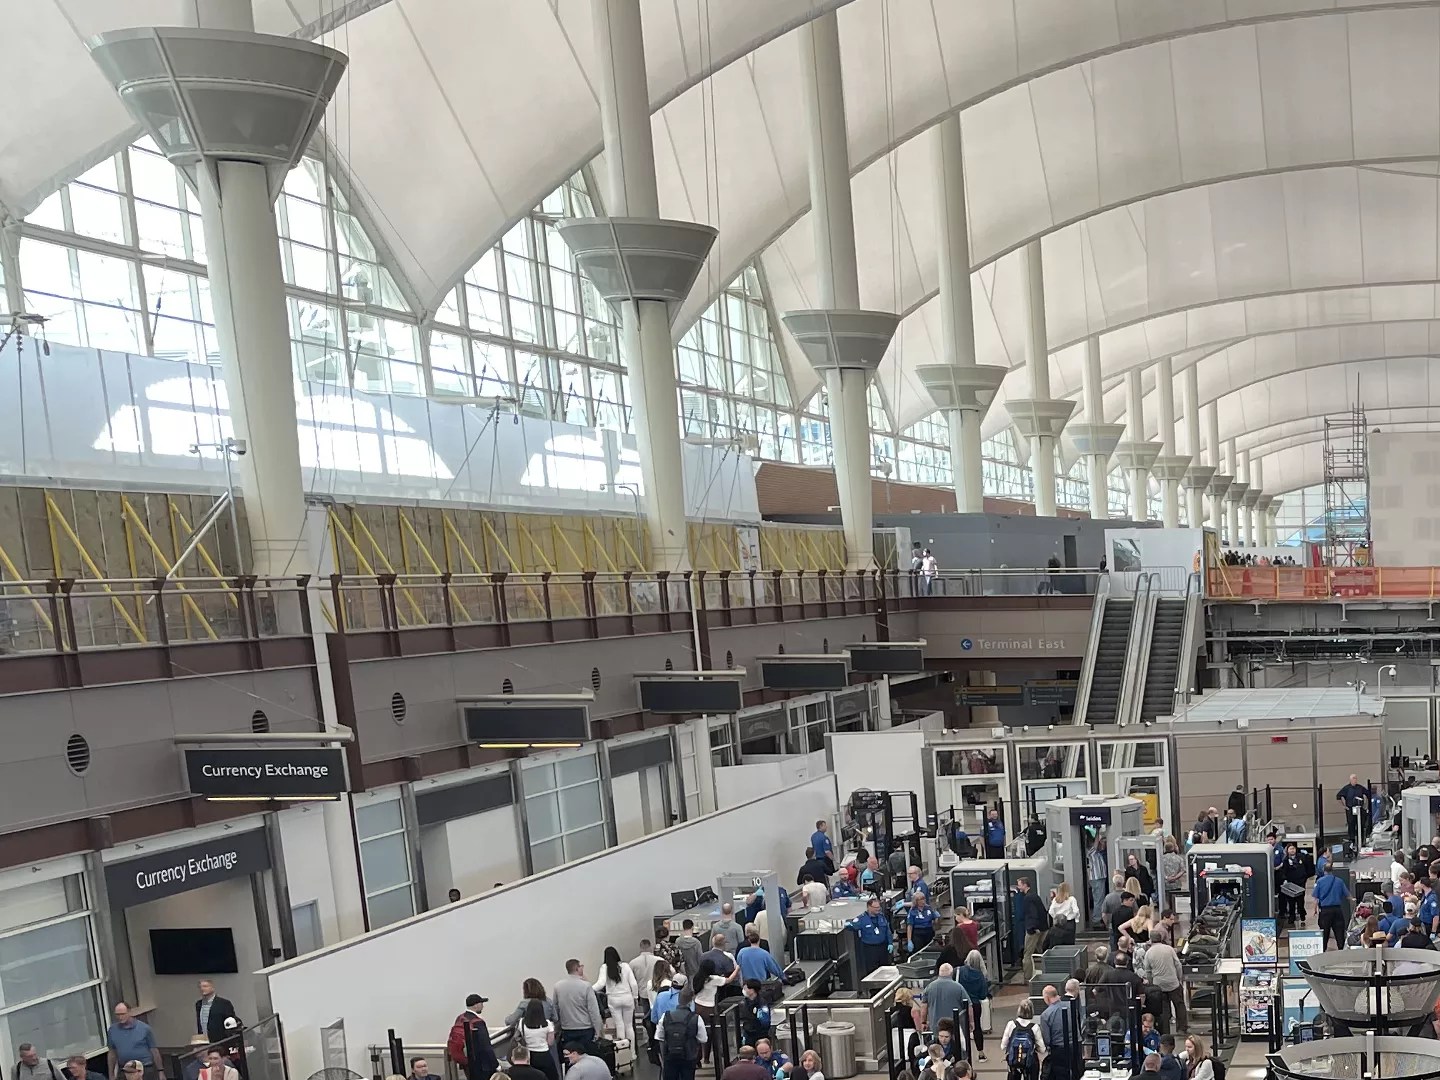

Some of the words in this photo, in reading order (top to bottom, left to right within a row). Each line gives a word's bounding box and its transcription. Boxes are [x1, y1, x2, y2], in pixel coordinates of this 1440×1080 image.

[978, 638, 1033, 650] Terminal
[1038, 639, 1066, 649] East
[202, 764, 262, 779] Currency
[264, 763, 329, 779] Exchange
[136, 863, 187, 890] Currency
[188, 850, 238, 876] Exchange
[752, 877, 762, 887] 10
